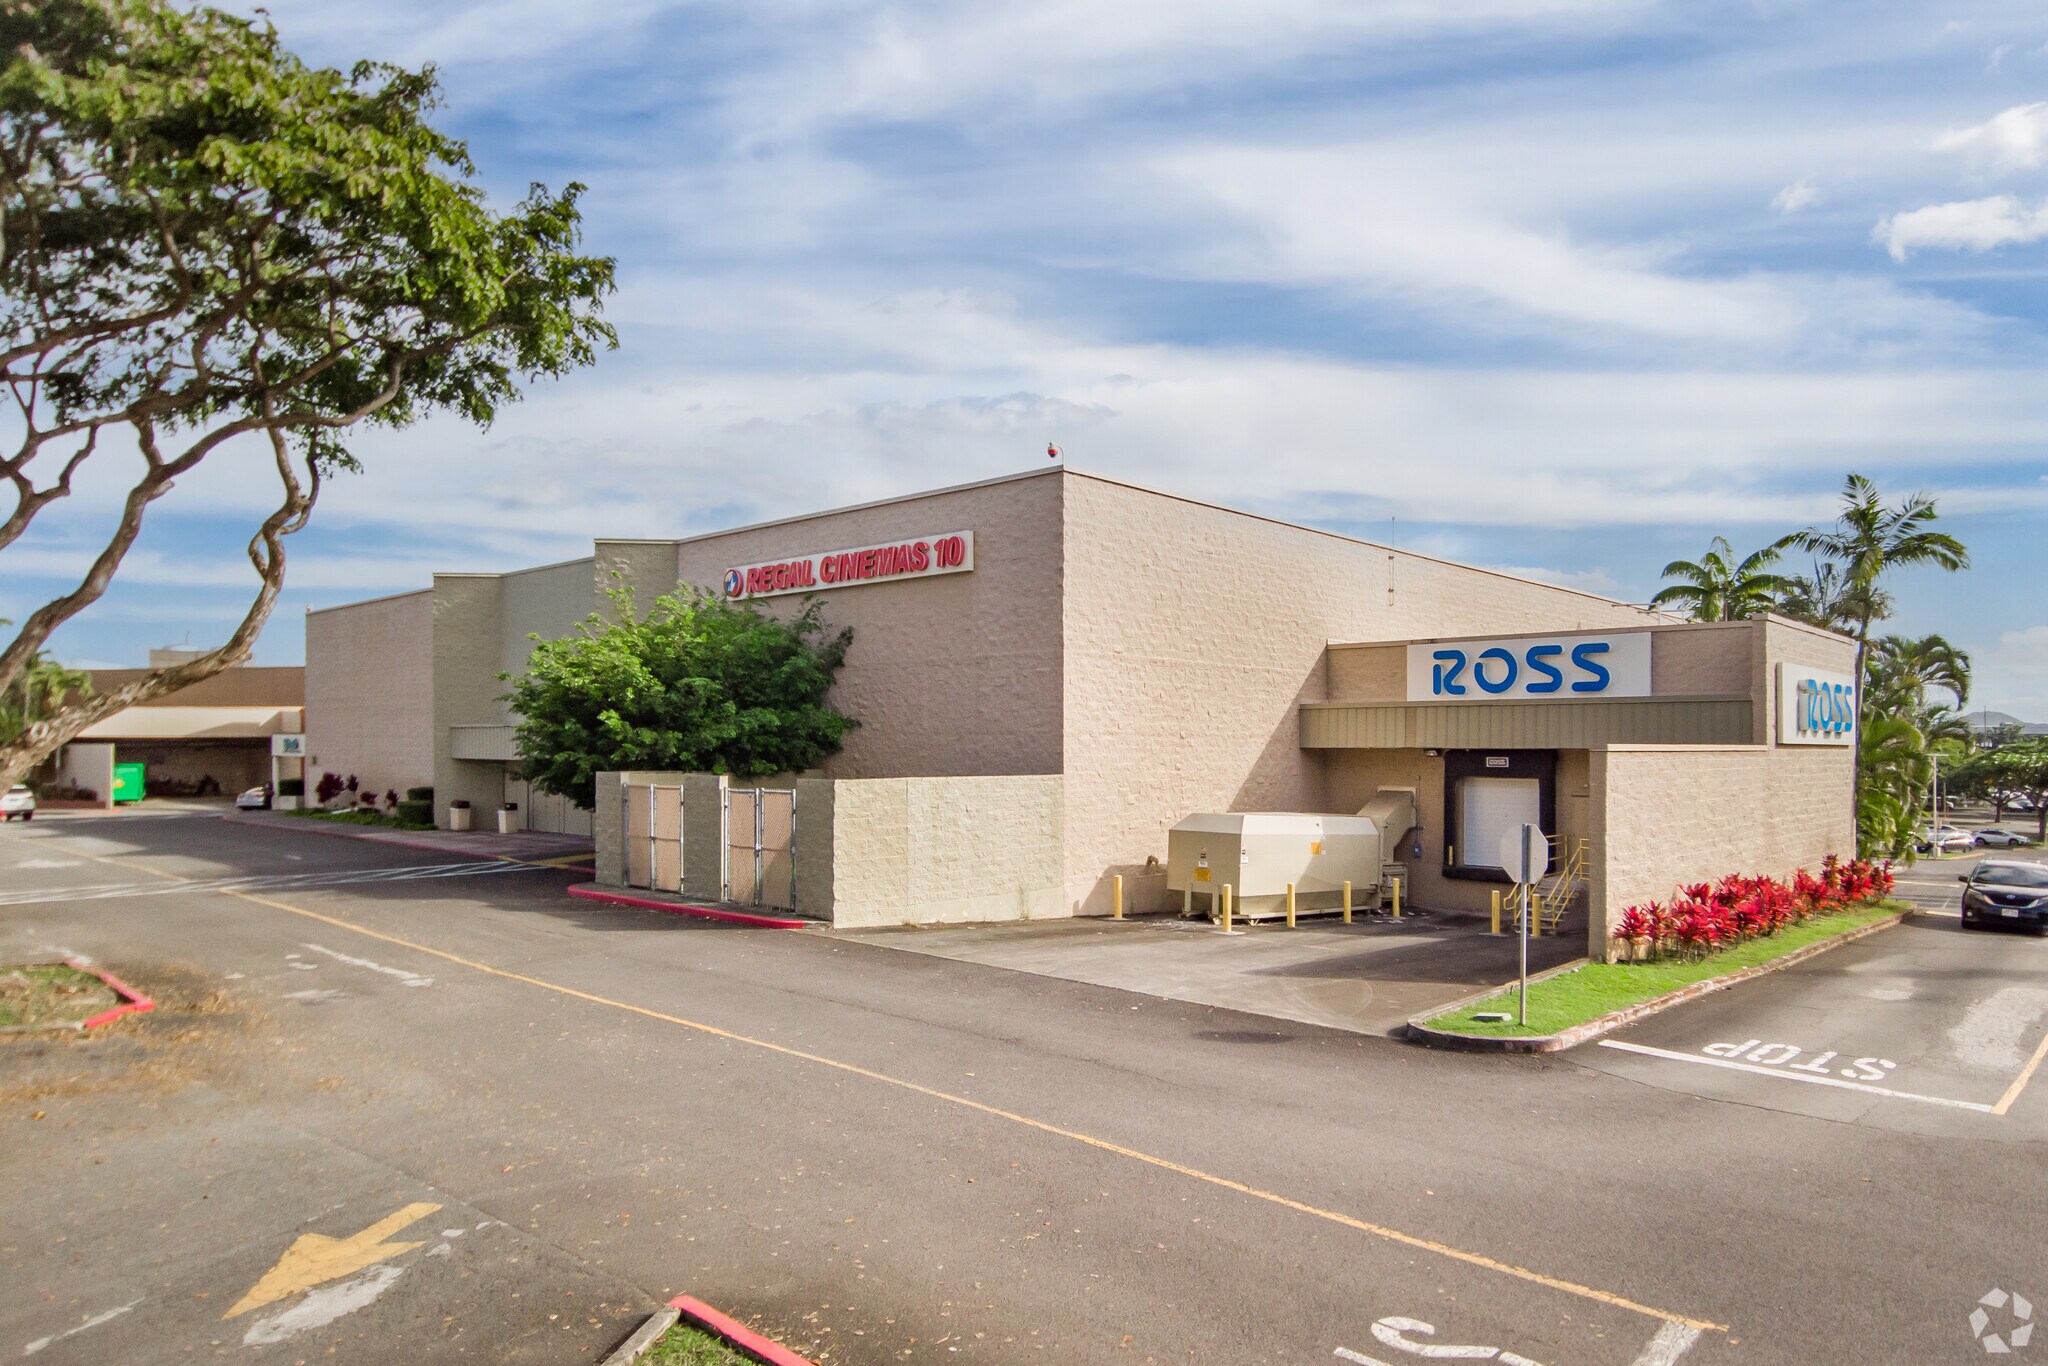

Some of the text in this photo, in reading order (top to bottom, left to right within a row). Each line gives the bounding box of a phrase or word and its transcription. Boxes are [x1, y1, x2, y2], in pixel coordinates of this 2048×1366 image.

[746, 536, 965, 593] REGAL CINEMAS 10
[1432, 642, 1611, 695] ROSS
[1799, 678, 1853, 733] ROSS
[1702, 1039, 1897, 1081] STOP
